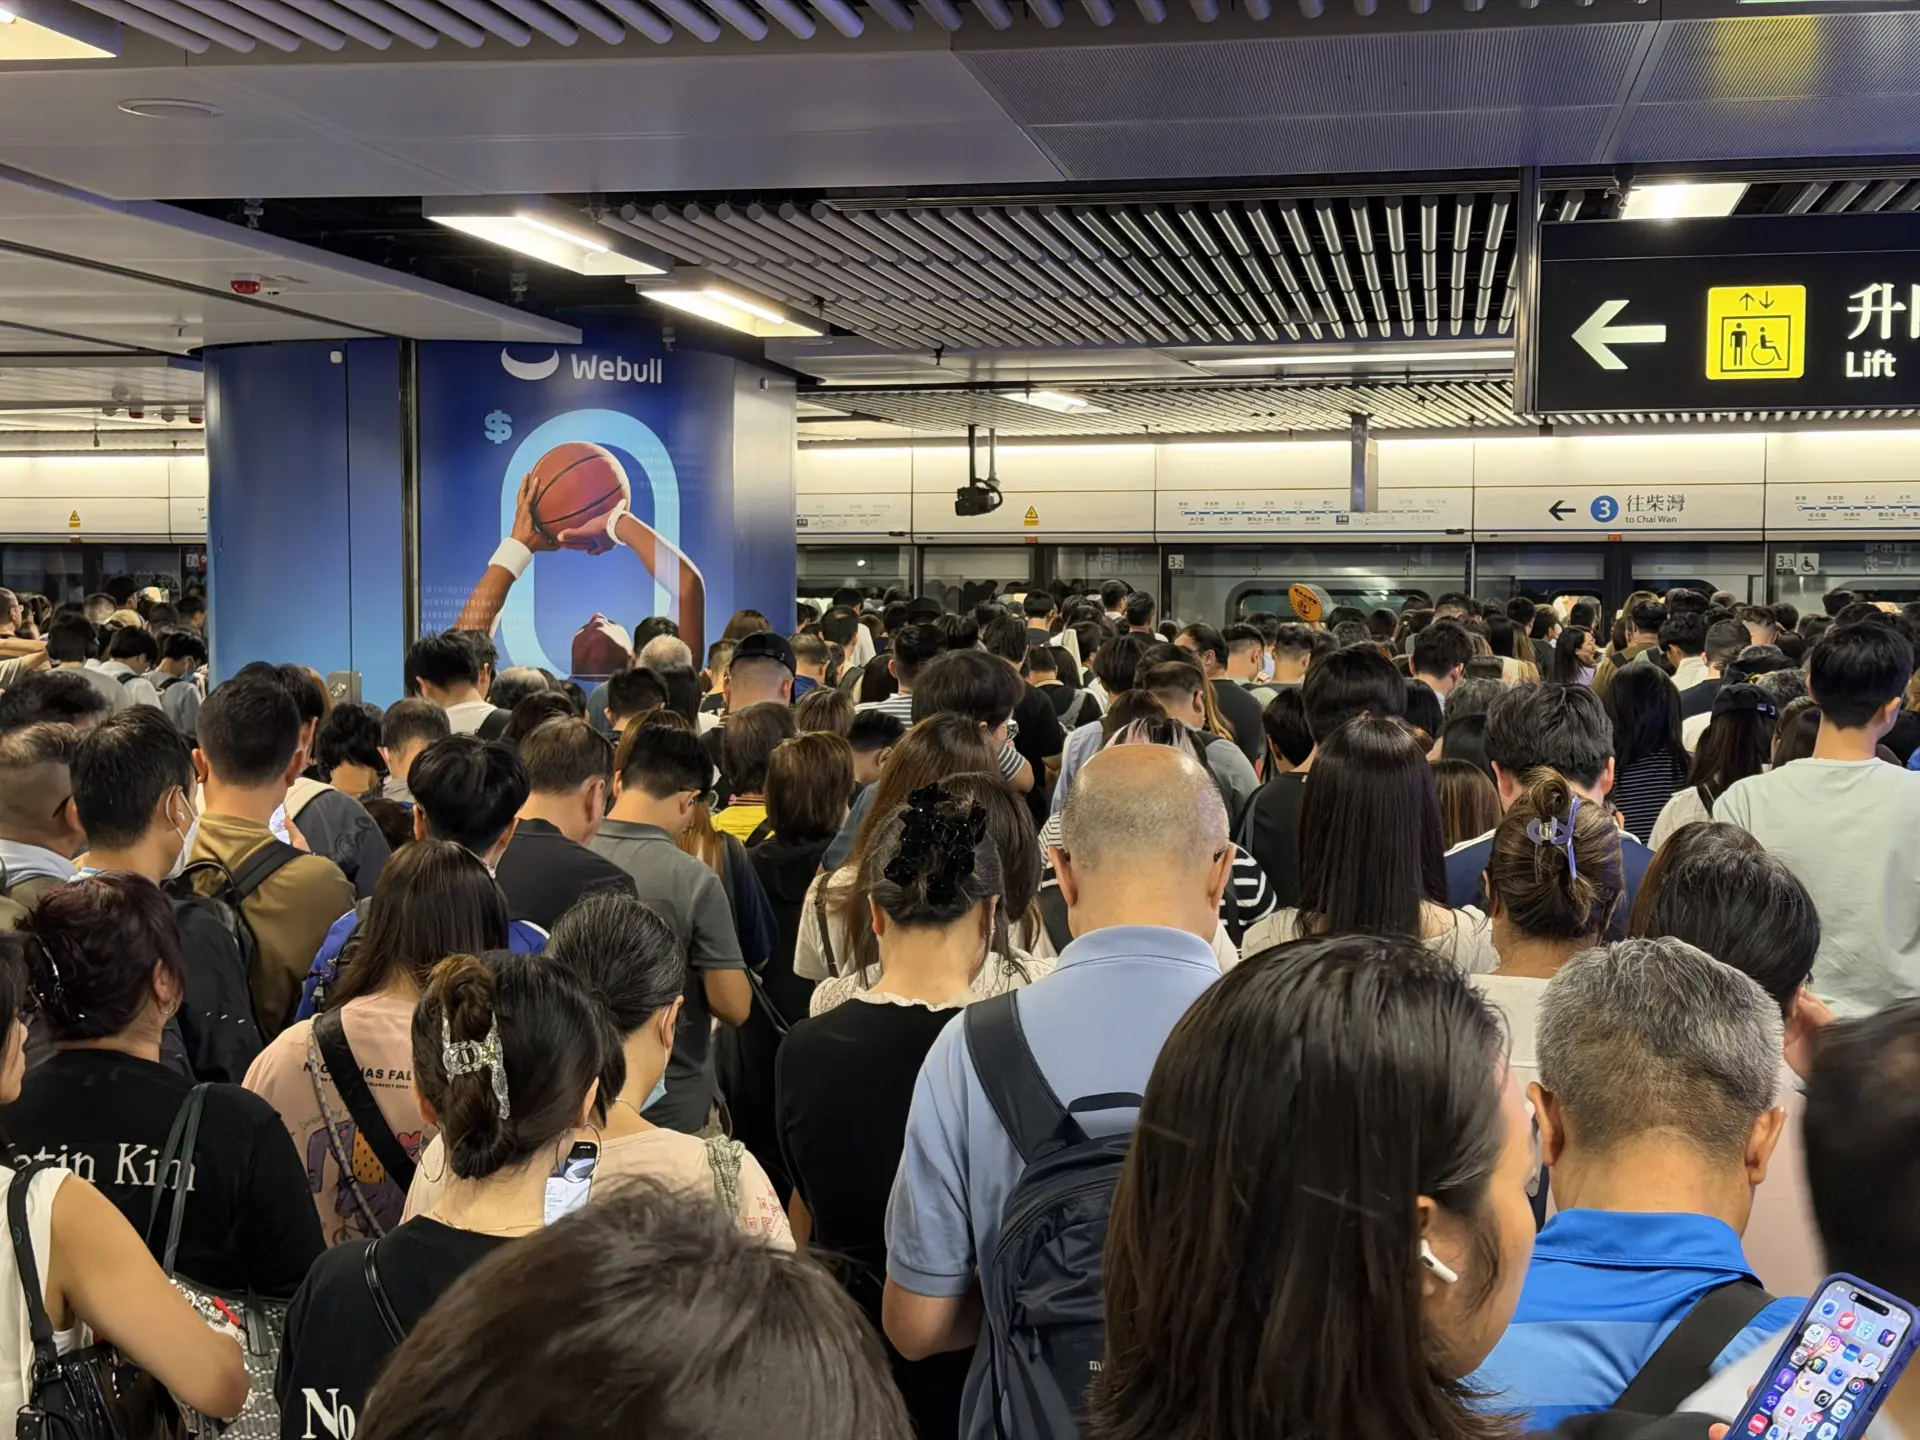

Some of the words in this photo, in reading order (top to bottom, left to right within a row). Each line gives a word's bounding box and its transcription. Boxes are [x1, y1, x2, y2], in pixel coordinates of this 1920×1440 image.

[571, 354, 663, 384] Webull
[1846, 349, 1897, 378] Lift
[1598, 499, 1611, 519] 3
[1626, 494, 1686, 513] 往柴灣
[1625, 516, 1635, 524] to
[1637, 515, 1656, 524] Chai
[1658, 515, 1678, 524] Wan
[7, 1142, 96, 1184] atin
[114, 1142, 196, 1192] Kim
